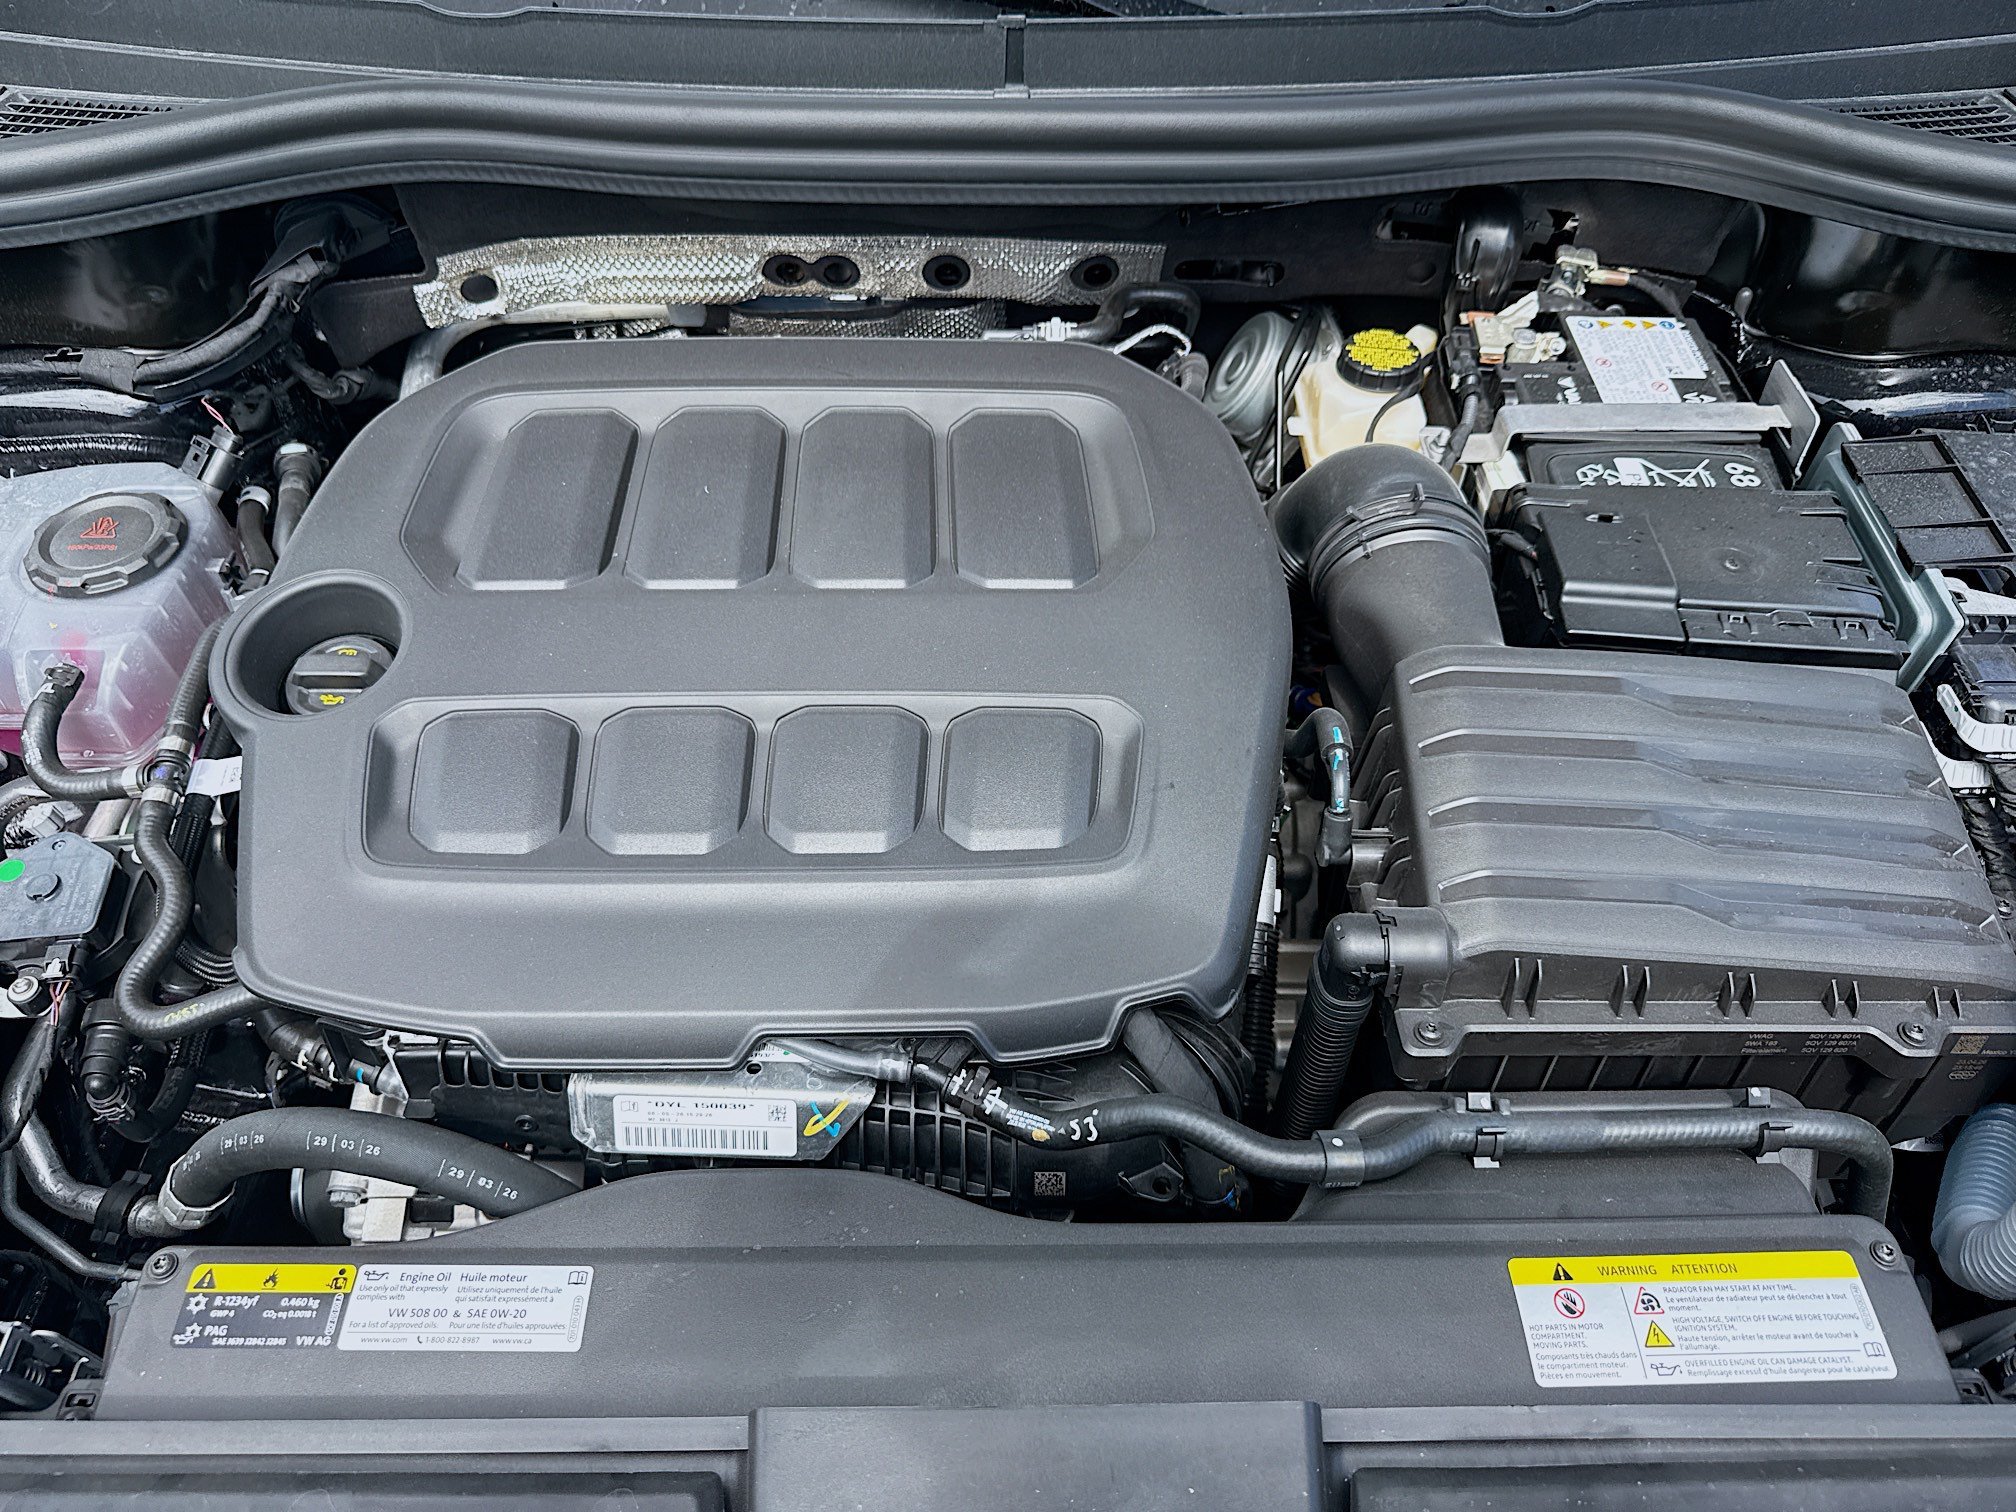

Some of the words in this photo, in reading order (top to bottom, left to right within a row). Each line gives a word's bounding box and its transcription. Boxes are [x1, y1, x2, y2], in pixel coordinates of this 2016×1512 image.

[314, 1136, 328, 1147] 29
[341, 1140, 355, 1150] 03
[366, 1144, 381, 1156] 26
[449, 1166, 464, 1179] 29
[503, 1187, 518, 1200] 26
[1597, 1264, 1658, 1276] WARNING
[1671, 1263, 1738, 1275] ATTENTION
[400, 1272, 434, 1284] Engine
[437, 1272, 452, 1282] Oil
[460, 1272, 486, 1282] Huile
[490, 1273, 528, 1282] moteur
[374, 1284, 388, 1294] only
[416, 1284, 448, 1294] expressly
[485, 1286, 528, 1296] uniquement
[213, 1294, 260, 1310] R-1234yf
[310, 1297, 320, 1308] kg
[356, 1293, 388, 1302] complies
[455, 1295, 466, 1304] qui
[498, 1295, 548, 1304] expressément
[1760, 1295, 1776, 1303] peut
[388, 1308, 408, 1318] VW
[410, 1308, 431, 1318] 508
[433, 1308, 448, 1318] 00
[452, 1310, 462, 1318] &
[467, 1309, 488, 1318] SAE
[490, 1309, 527, 1318] 0W-20
[389, 1321, 424, 1330] approved
[204, 1325, 229, 1337] PAG
[1732, 1333, 1756, 1341] arrêter
[1824, 1331, 1852, 1339] toucher
[212, 1338, 226, 1346] SAE
[296, 1336, 314, 1346] VW
[314, 1336, 332, 1346] AG
[1536, 1352, 1578, 1361] Composants
[1595, 1352, 1618, 1360] chauds
[1620, 1351, 1637, 1359] dans
[1546, 1362, 1598, 1371] compartiment
[1540, 1372, 1563, 1380] Pièces
[1688, 1369, 1732, 1378] Remplissage
[1734, 1368, 1762, 1376] excessif
[1788, 1366, 1826, 1376] dangereux
[1827, 1367, 1843, 1375] pour
